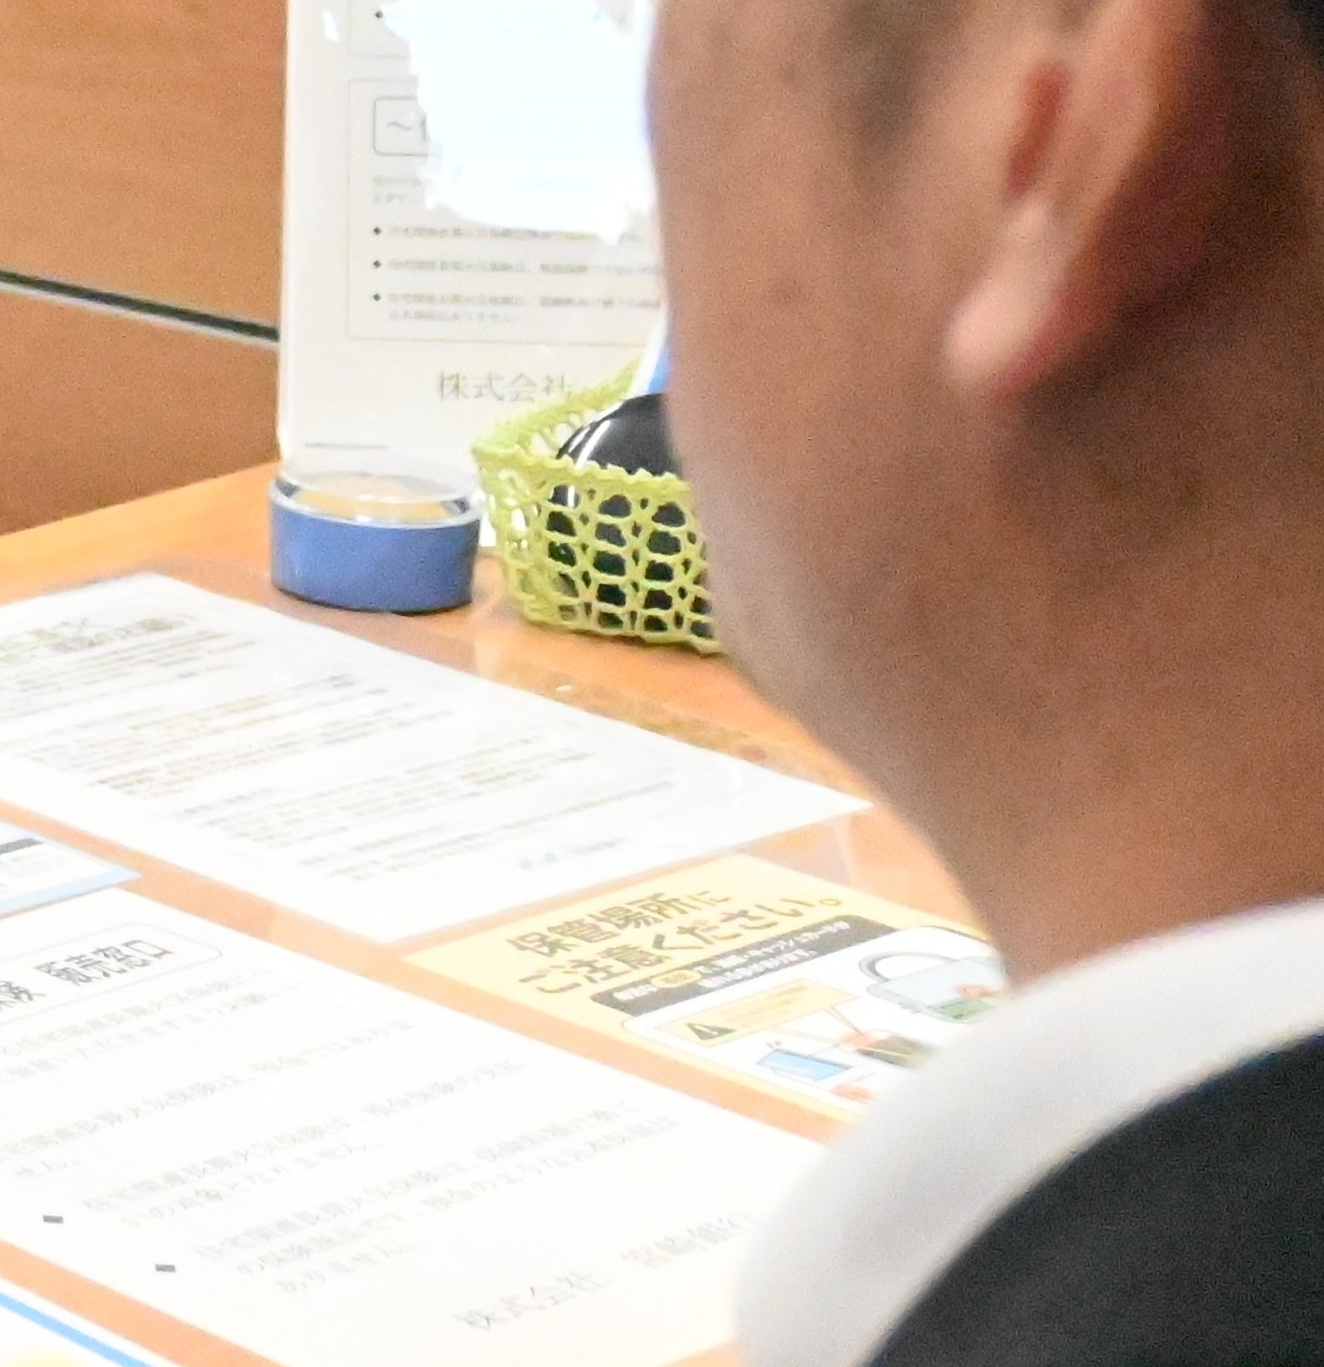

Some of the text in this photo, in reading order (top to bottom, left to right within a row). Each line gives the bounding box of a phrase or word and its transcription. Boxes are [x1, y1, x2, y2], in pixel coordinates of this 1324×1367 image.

[505, 891, 733, 958] 保管場所に
[518, 897, 842, 994] ご注意ください。
[34, 938, 175, 987] 販売窓口
